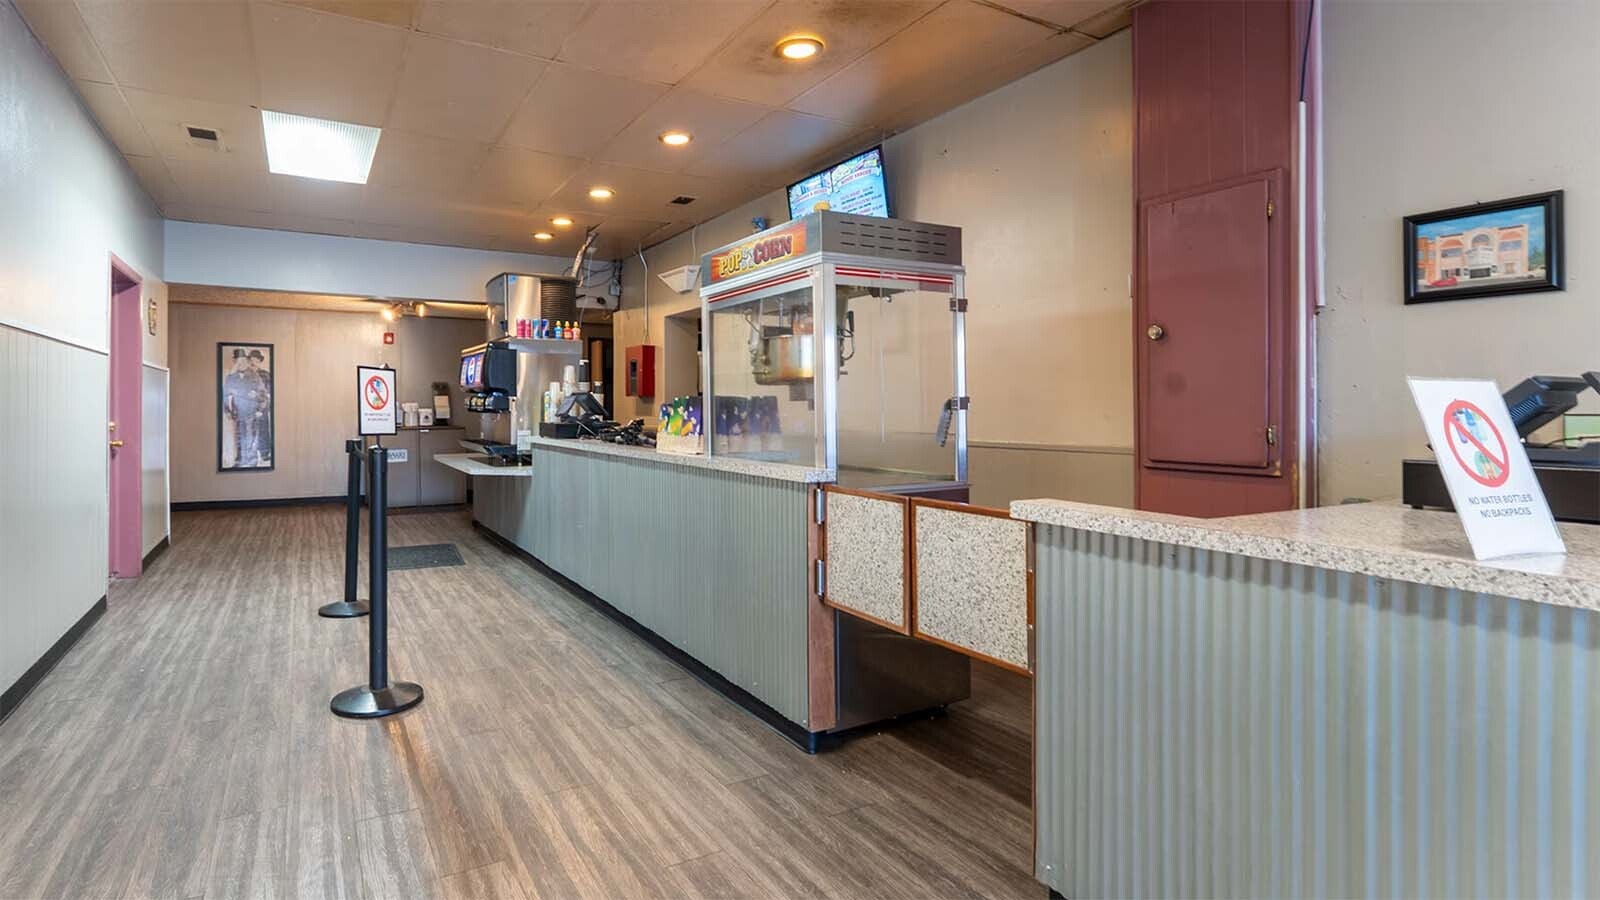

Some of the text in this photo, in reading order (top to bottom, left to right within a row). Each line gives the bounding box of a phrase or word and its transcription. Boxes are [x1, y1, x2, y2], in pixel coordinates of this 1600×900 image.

[720, 250, 742, 275] POP
[753, 235, 792, 264] CORN
[1468, 494, 1533, 505] NO WATER BOTTLES
[1480, 507, 1532, 518] NO BACKPACKS
